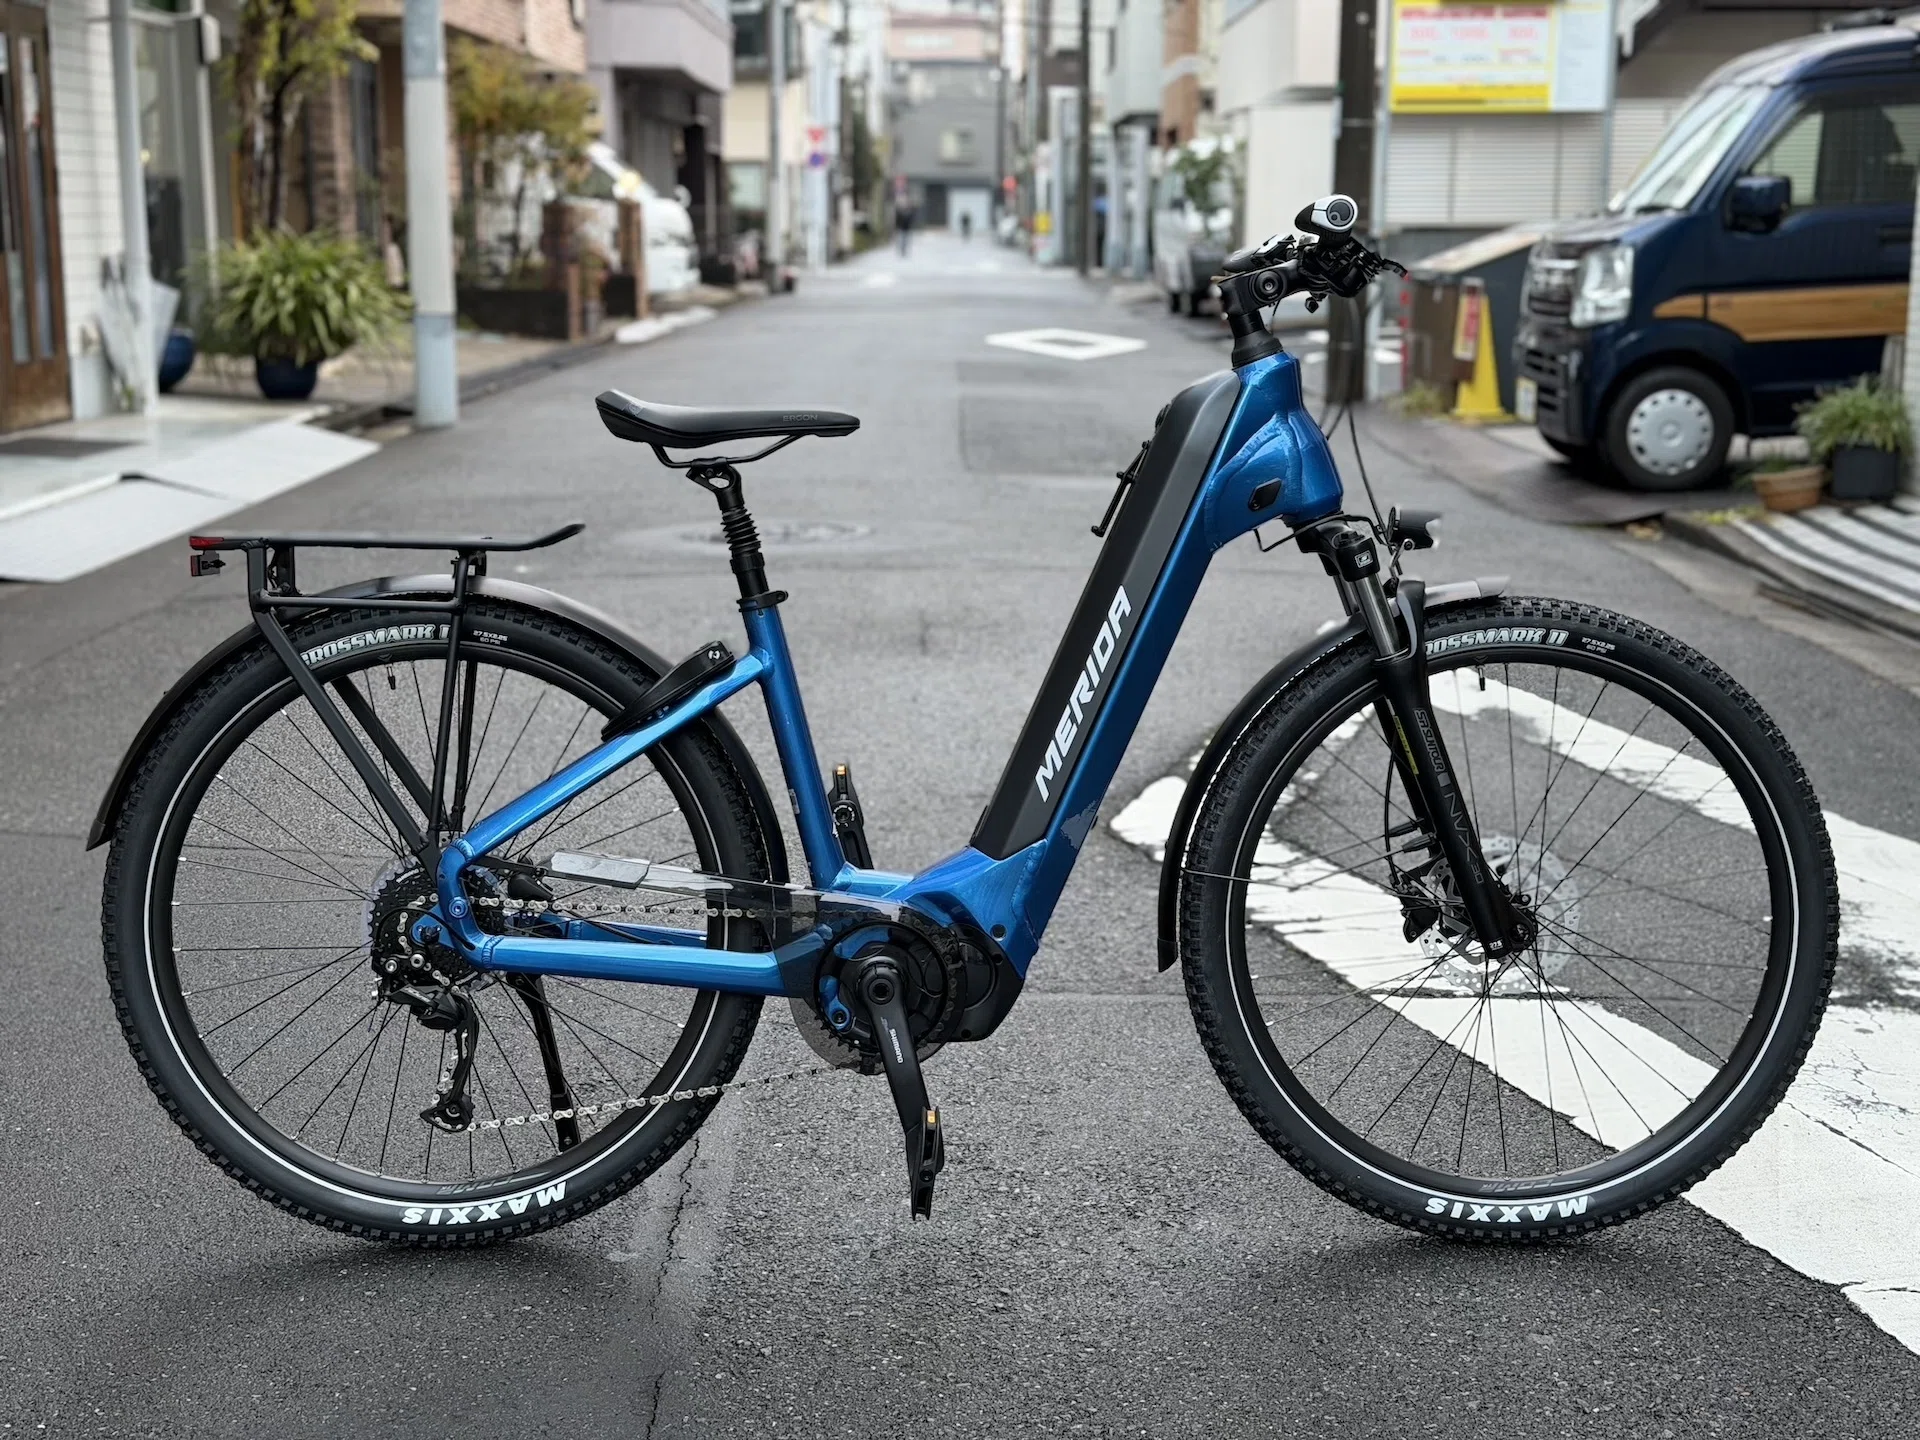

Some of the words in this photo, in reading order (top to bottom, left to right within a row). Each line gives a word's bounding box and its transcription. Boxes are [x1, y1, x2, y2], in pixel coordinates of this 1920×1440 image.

[782, 414, 818, 422] ERGON
[1035, 585, 1132, 803] MERIDA
[1422, 727, 1446, 772] SUNTOUR
[889, 1028, 904, 1064] SHIMANO
[402, 1181, 567, 1226] MAXXIS
[1424, 1195, 1590, 1223] MAXXIS
